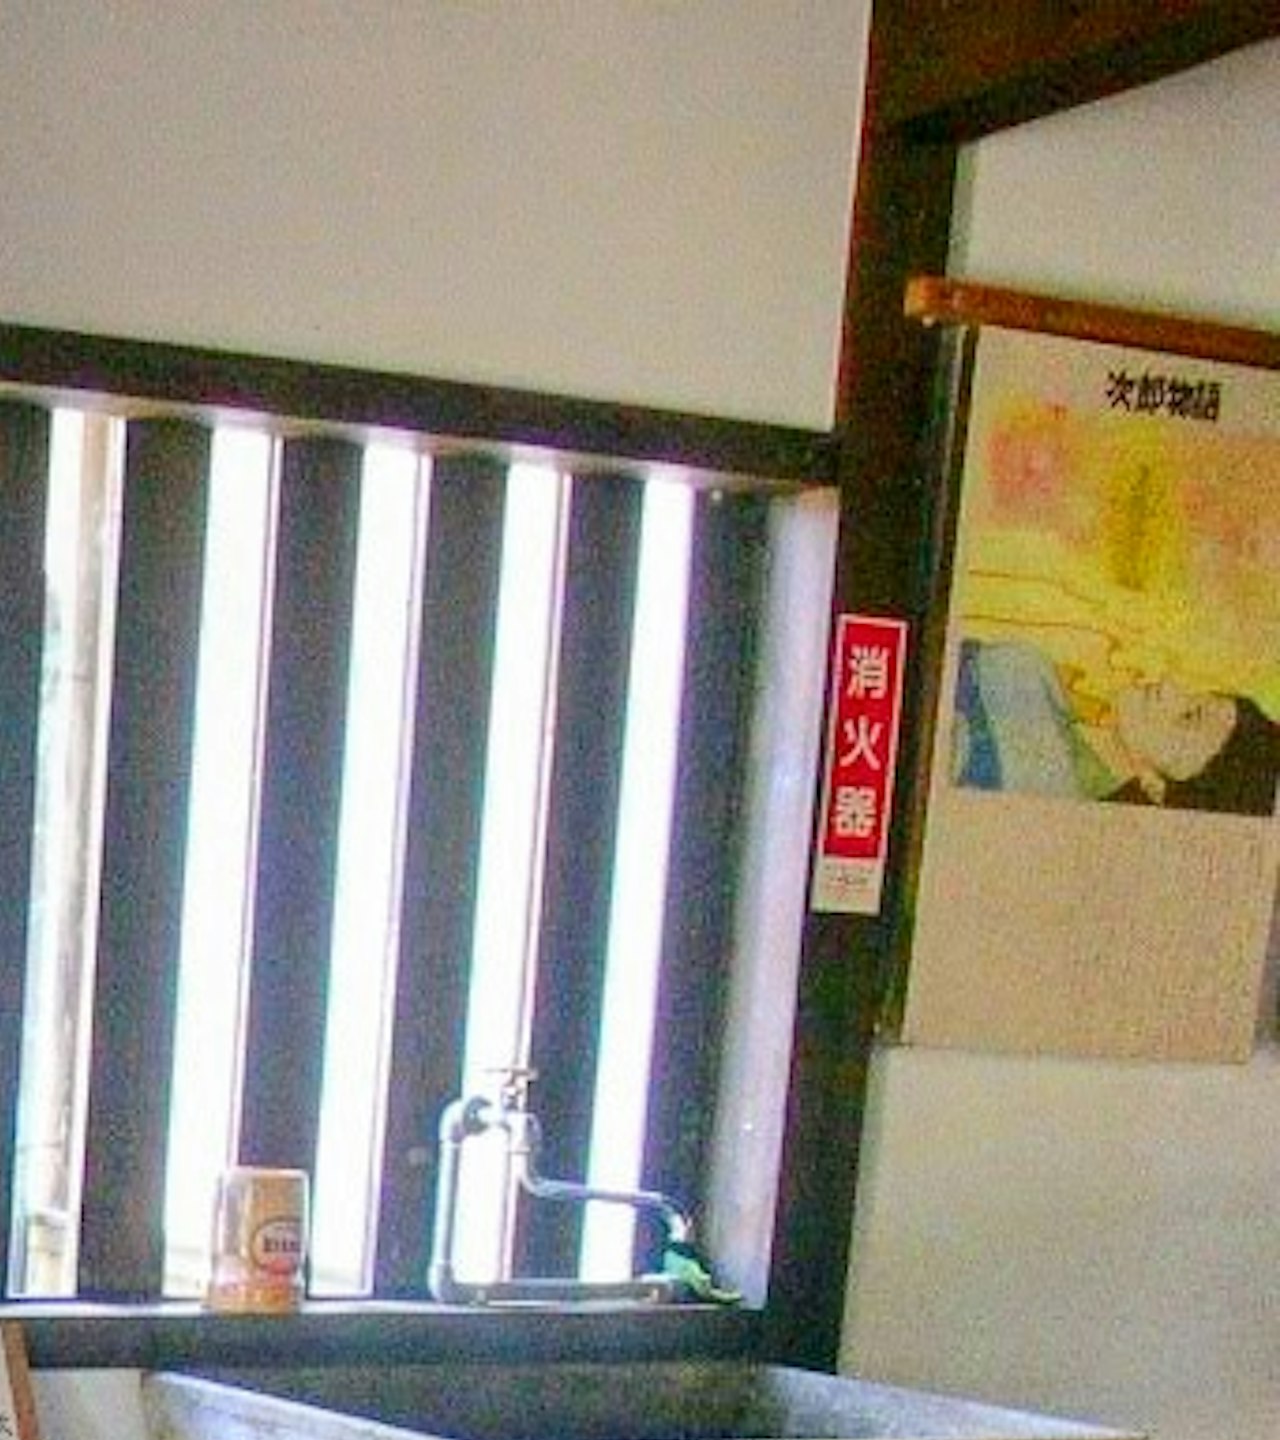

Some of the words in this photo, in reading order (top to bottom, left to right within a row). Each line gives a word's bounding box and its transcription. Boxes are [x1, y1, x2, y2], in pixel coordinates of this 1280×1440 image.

[1105, 368, 1223, 423] 次郎物語
[832, 645, 892, 840] 消火器
